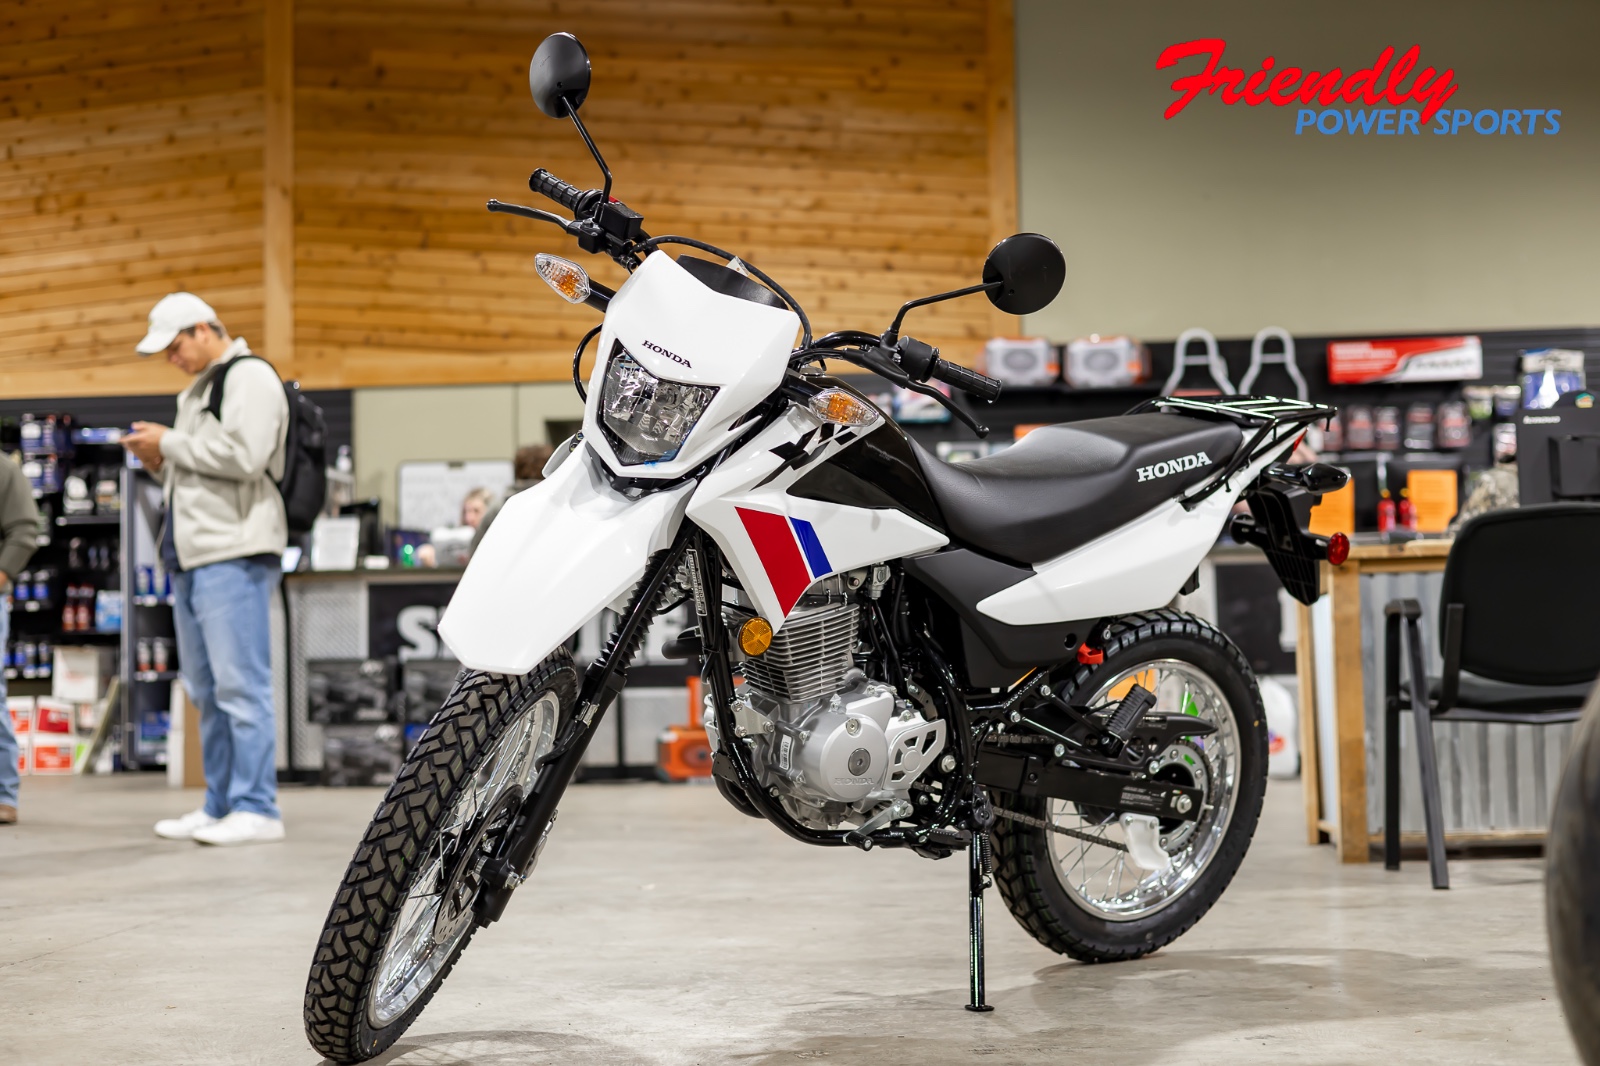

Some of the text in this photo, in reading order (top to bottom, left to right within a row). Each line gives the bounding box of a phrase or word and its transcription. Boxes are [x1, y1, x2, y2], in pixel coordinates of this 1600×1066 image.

[642, 340, 692, 369] HONDA
[1136, 452, 1213, 483] HONDA
[834, 777, 875, 786] HONDA
